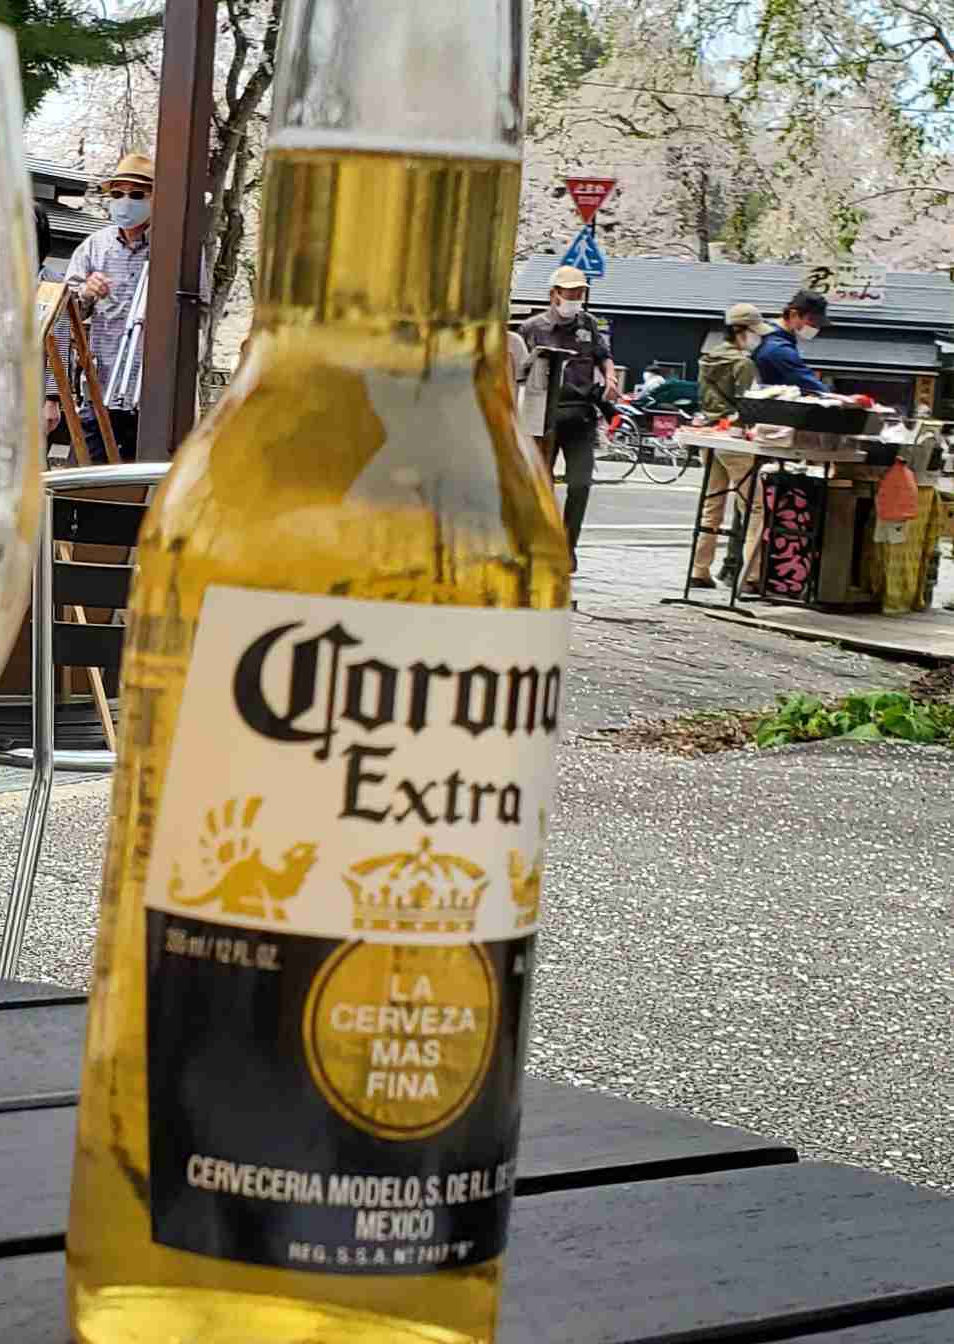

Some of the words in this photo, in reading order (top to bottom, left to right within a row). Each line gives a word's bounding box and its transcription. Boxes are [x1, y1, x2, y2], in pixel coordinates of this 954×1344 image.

[232, 618, 561, 761] Corona
[338, 744, 521, 825] Extra
[390, 975, 432, 1001] LA
[331, 1006, 476, 1034] CERVEZA
[371, 1038, 441, 1068] MAS
[366, 1071, 440, 1100] FINA
[187, 1154, 322, 1204] CERVECERIA
[355, 1208, 435, 1242] MEXICO
